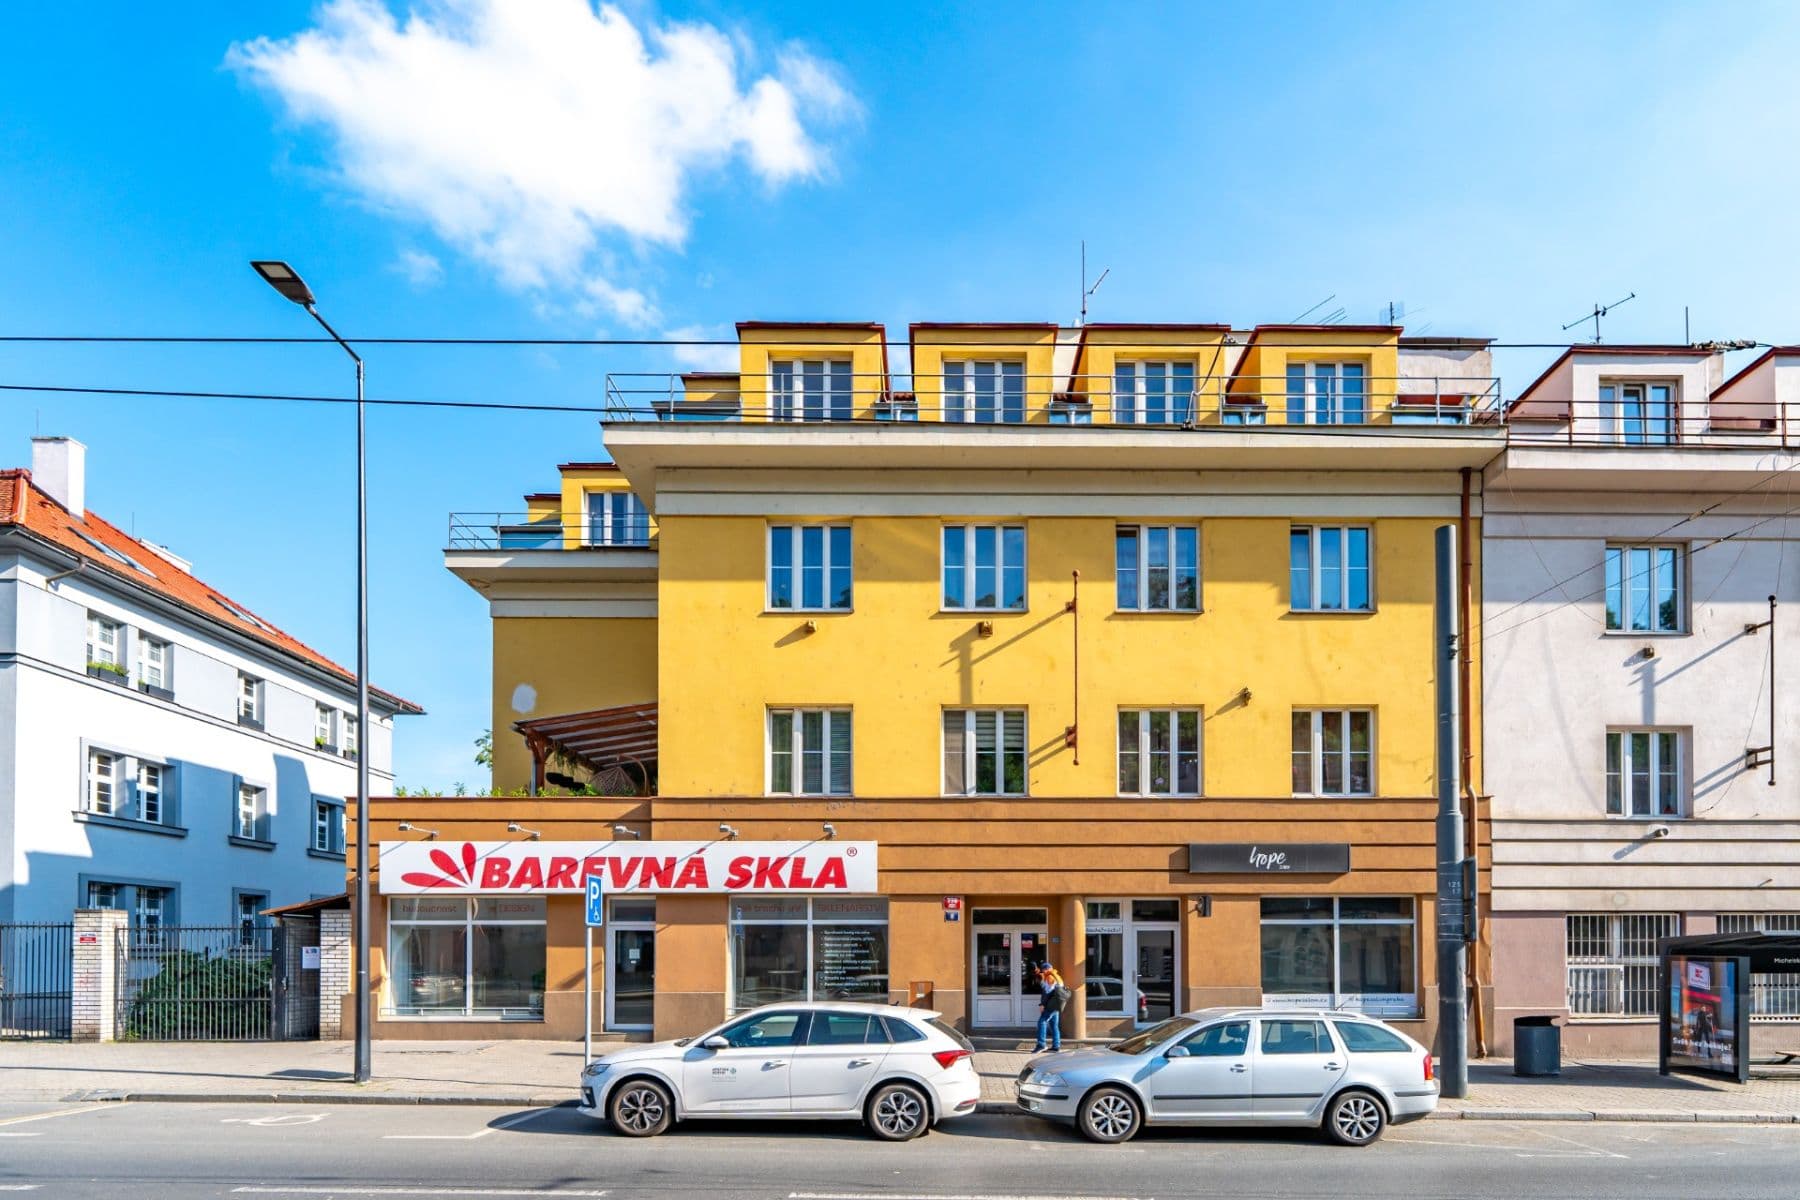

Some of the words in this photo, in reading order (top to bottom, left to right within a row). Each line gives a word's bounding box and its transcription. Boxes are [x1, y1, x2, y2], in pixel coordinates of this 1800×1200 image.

[480, 848, 709, 889] BAREVNÁ
[723, 855, 848, 889] SKLA
[1249, 846, 1287, 870] hope
[590, 881, 600, 910] P
